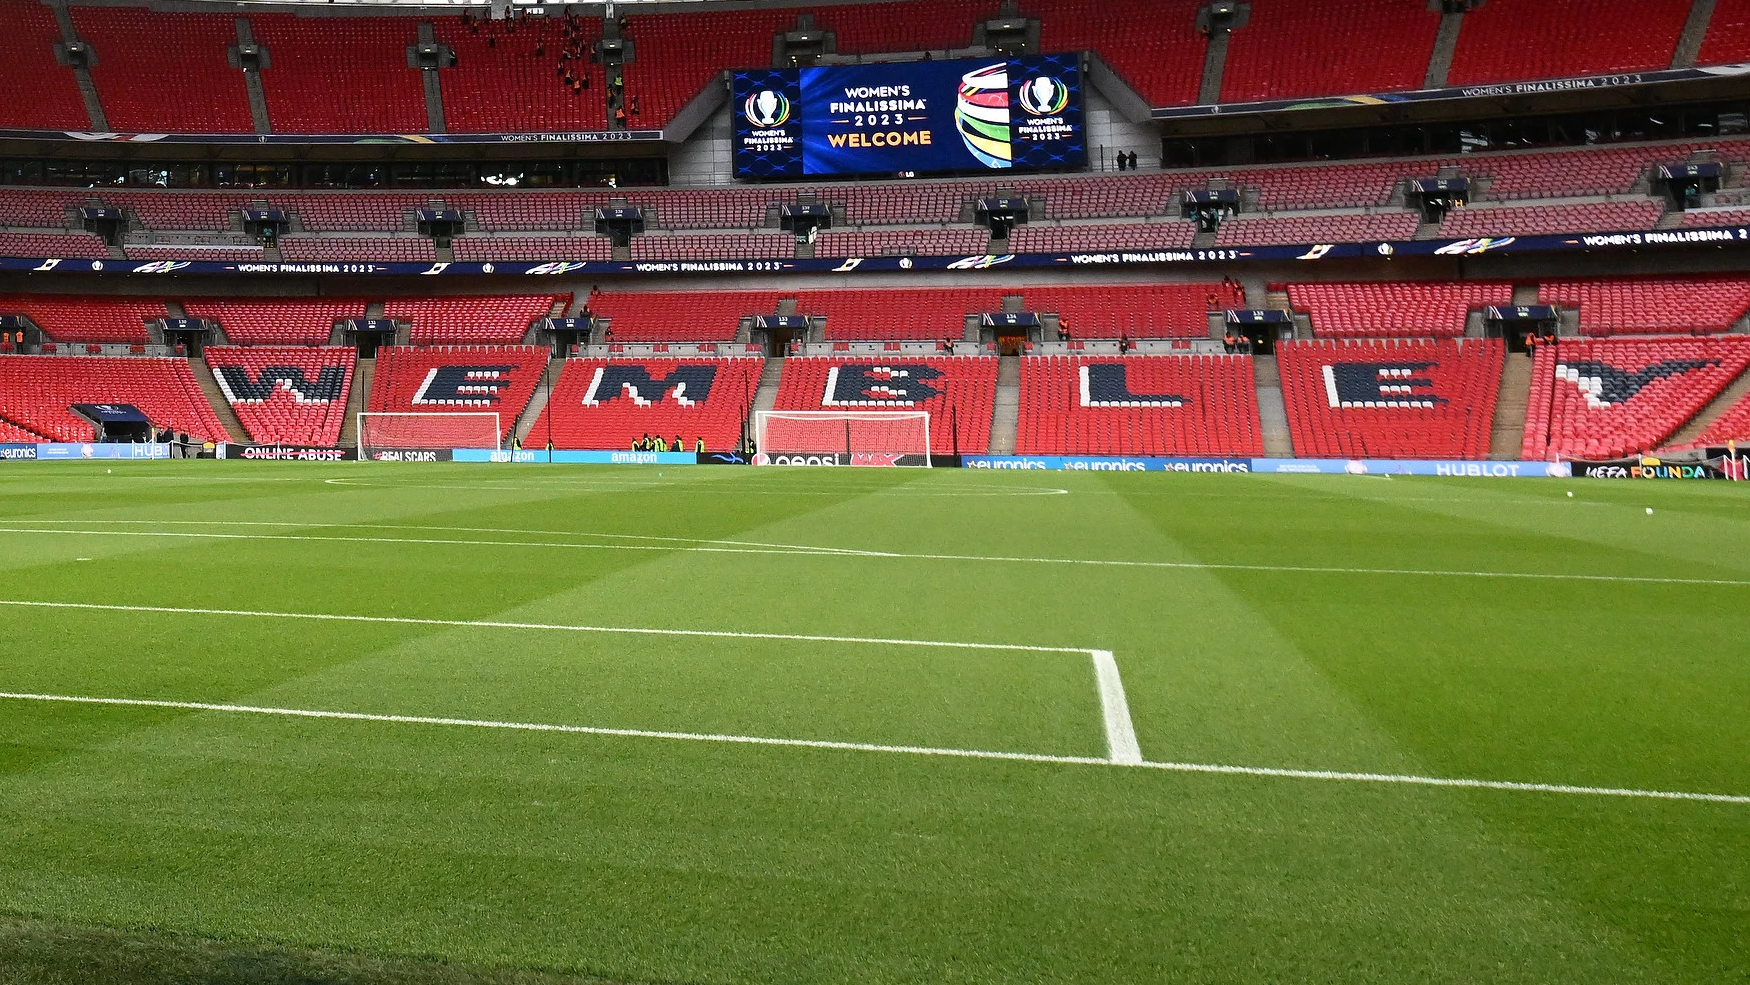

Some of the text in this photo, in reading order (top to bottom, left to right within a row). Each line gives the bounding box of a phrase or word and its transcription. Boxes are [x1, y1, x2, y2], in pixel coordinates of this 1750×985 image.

[844, 85, 910, 99] WOMEN'S
[1462, 74, 1643, 97] WOMEN'S FINALISSIMA 2023
[830, 99, 926, 114] FINALISSIMA
[854, 113, 904, 126] 2023
[1026, 117, 1064, 126] WOMEN'S
[751, 129, 785, 137] WOMEN'S
[1018, 125, 1072, 134] FINALISSIMA
[500, 132, 633, 142] WOMEN'S FINALISSIMA 2023
[743, 136, 793, 145] FINALISSIMA
[827, 130, 932, 148] WELCOME
[1031, 132, 1061, 141] 2023
[1583, 228, 1748, 246] WOMEN'S FINALISSIMA 2
[1070, 249, 1238, 265] WOMEN'S FINALISSIMA 2023
[238, 264, 374, 274] WOMEN'S FINALISSIMA 2023
[636, 261, 781, 272] WOMEN'S FINALISSIMA 2023
[4, 445, 36, 459] euronics
[244, 447, 343, 461] ONLINE ABUSE
[490, 451, 534, 462] amazon
[611, 451, 657, 463] amazon
[976, 457, 1046, 470] euronics
[1073, 457, 1146, 471] euronics
[1174, 457, 1248, 472] euronics
[1436, 463, 1520, 477] HUBLOT
[1585, 466, 1628, 479] UEFA
